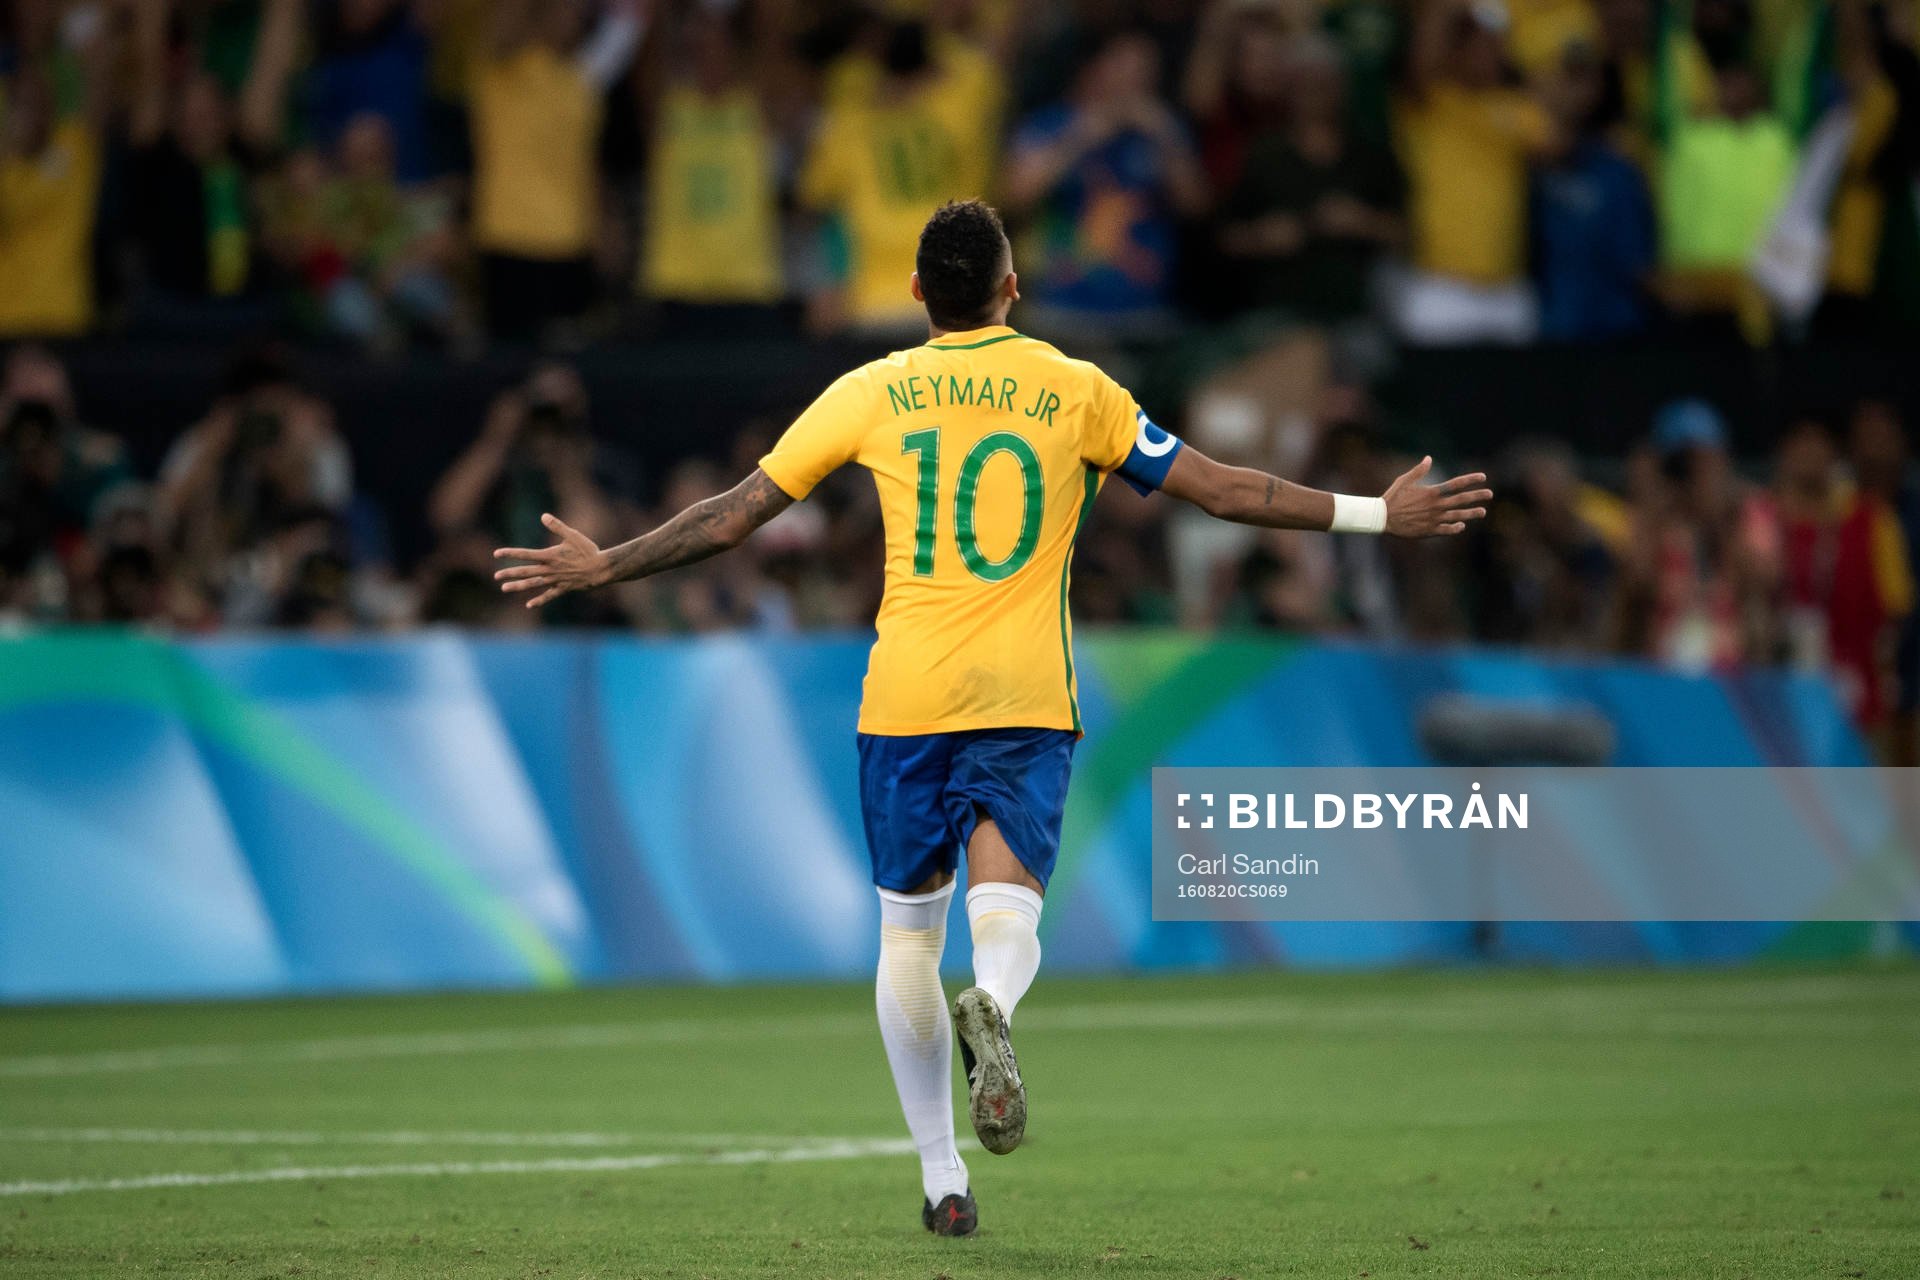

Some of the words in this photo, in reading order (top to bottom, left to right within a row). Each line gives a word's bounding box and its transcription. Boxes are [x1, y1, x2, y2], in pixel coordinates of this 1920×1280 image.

[887, 375, 1018, 416] NEYMAR
[1024, 388, 1061, 427] JR
[901, 426, 1045, 583] 10
